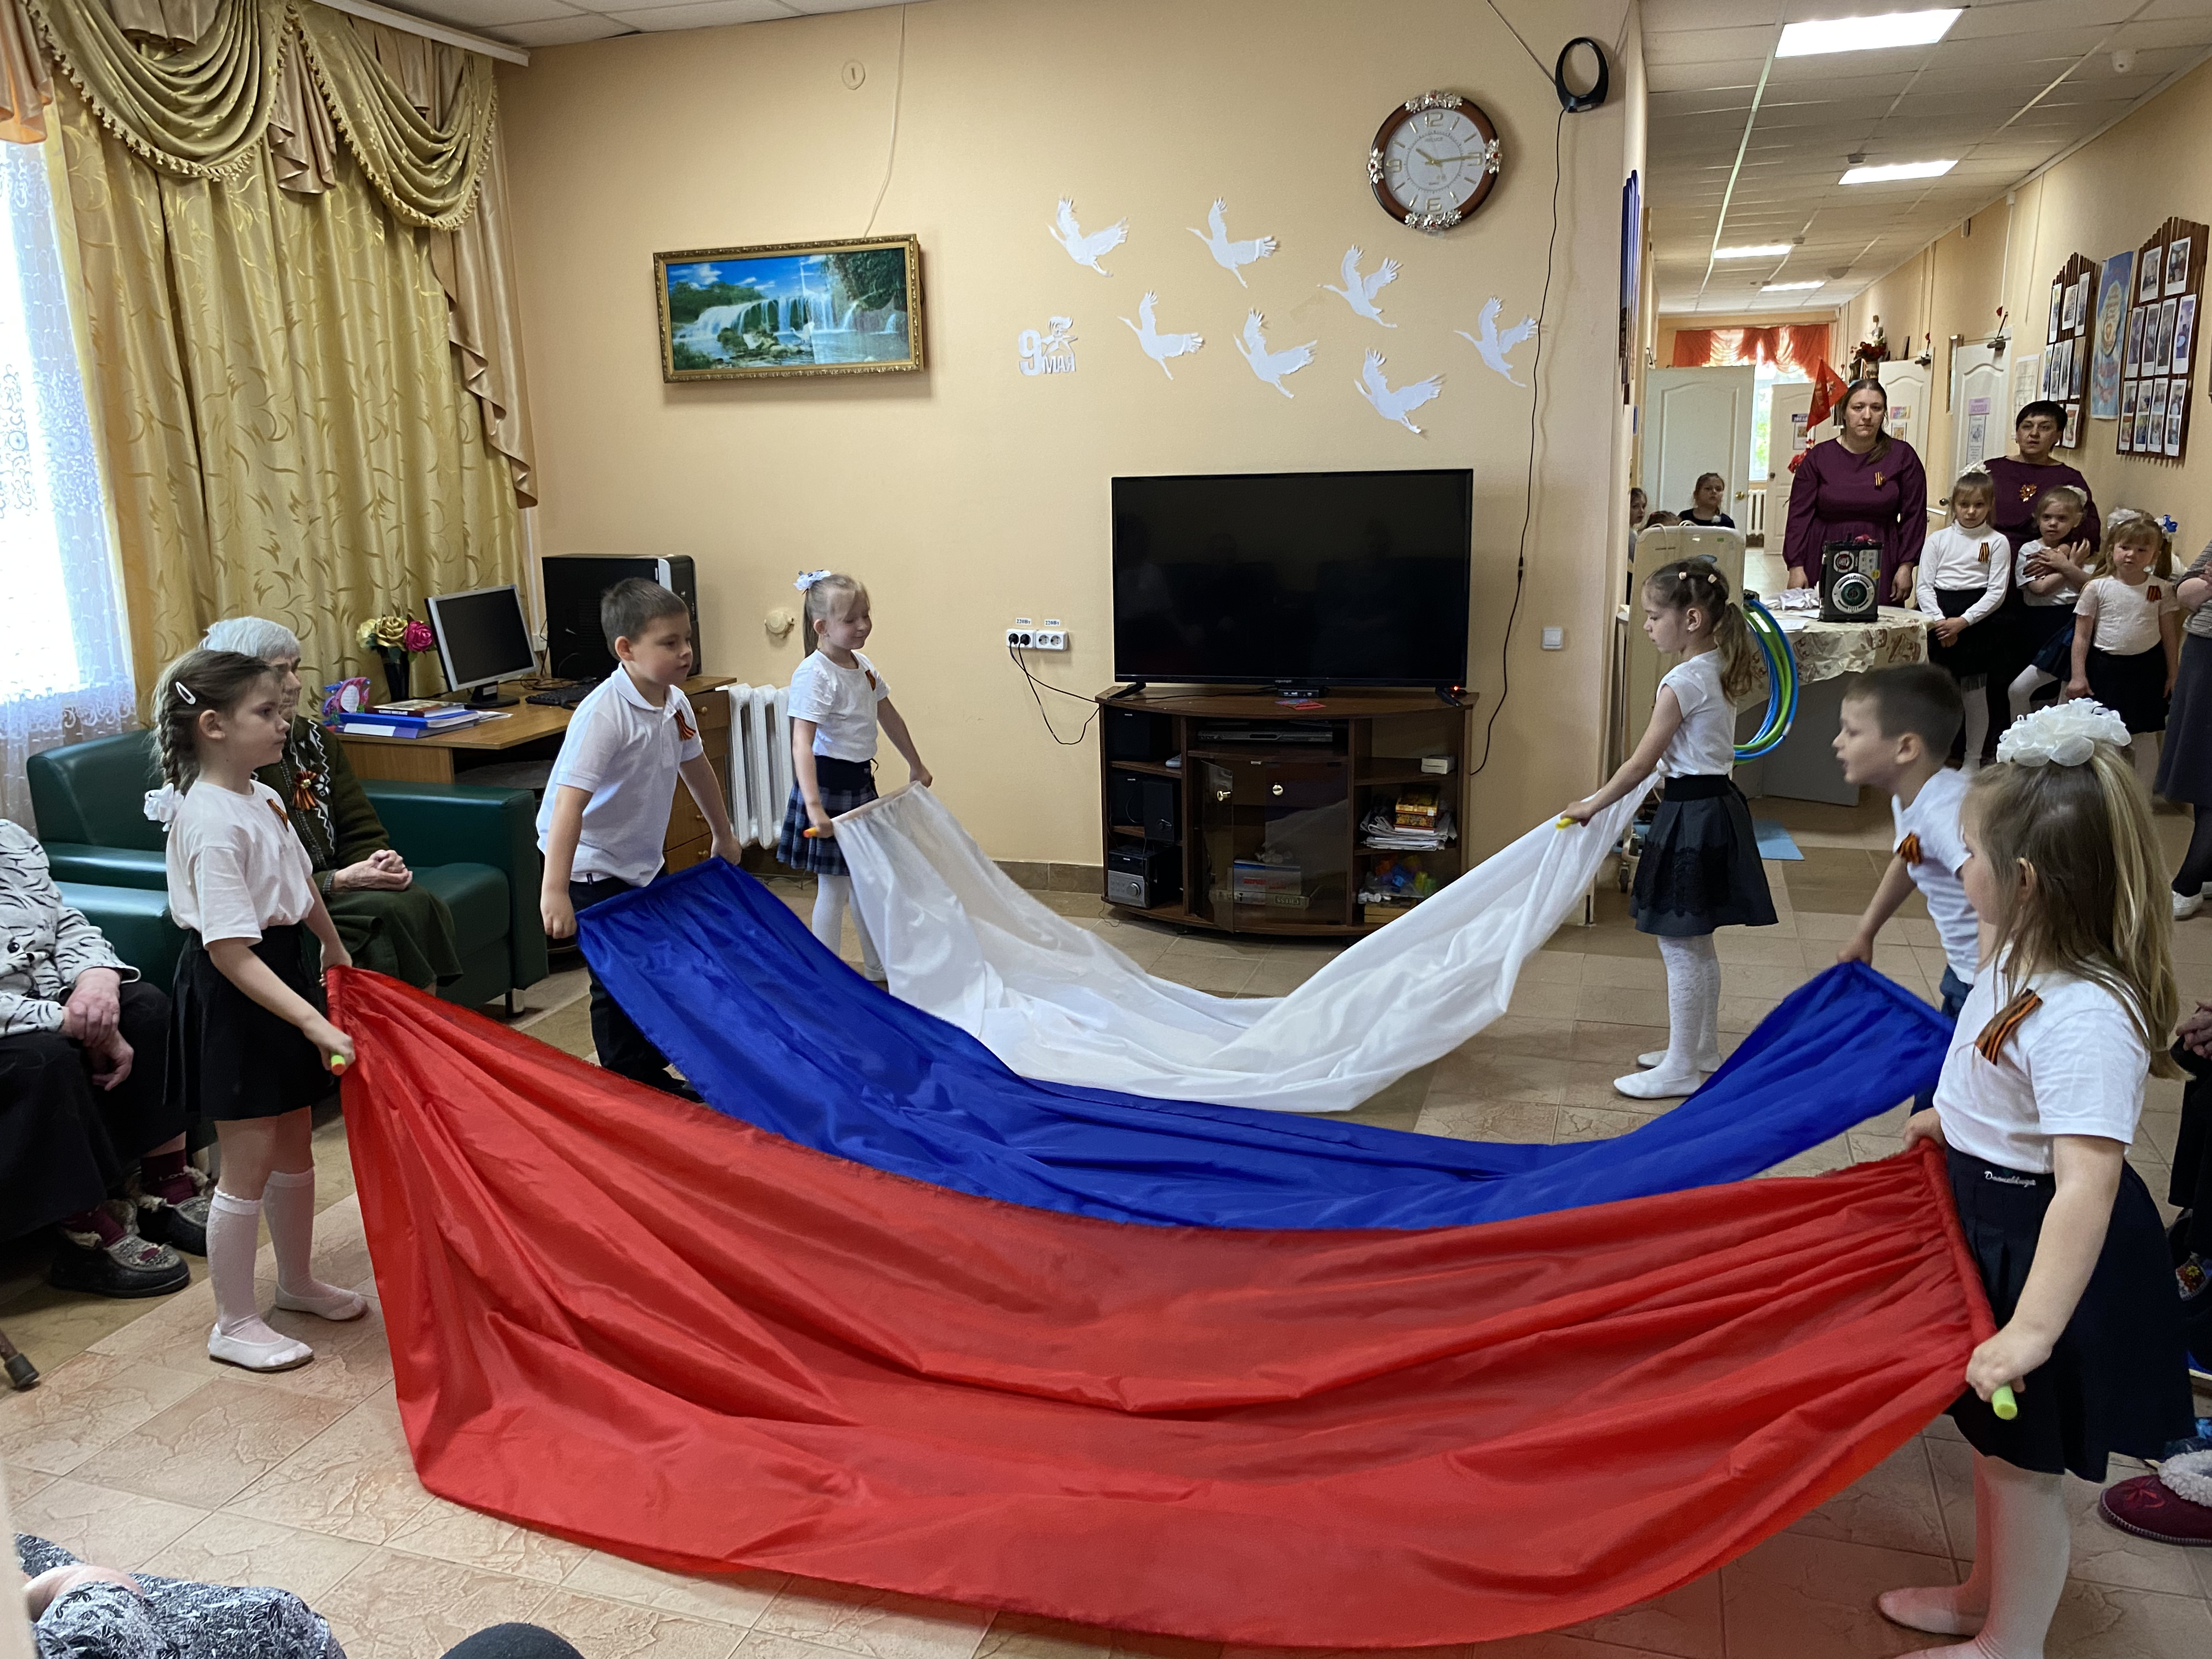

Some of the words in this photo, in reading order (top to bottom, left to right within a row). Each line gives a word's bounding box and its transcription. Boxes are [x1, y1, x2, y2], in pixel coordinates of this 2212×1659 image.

[1425, 112, 1444, 127] 12
[1386, 159, 1402, 173] 9
[1468, 151, 1482, 166] 3
[1426, 198, 1442, 213] 6
[1019, 329, 1042, 376] 9
